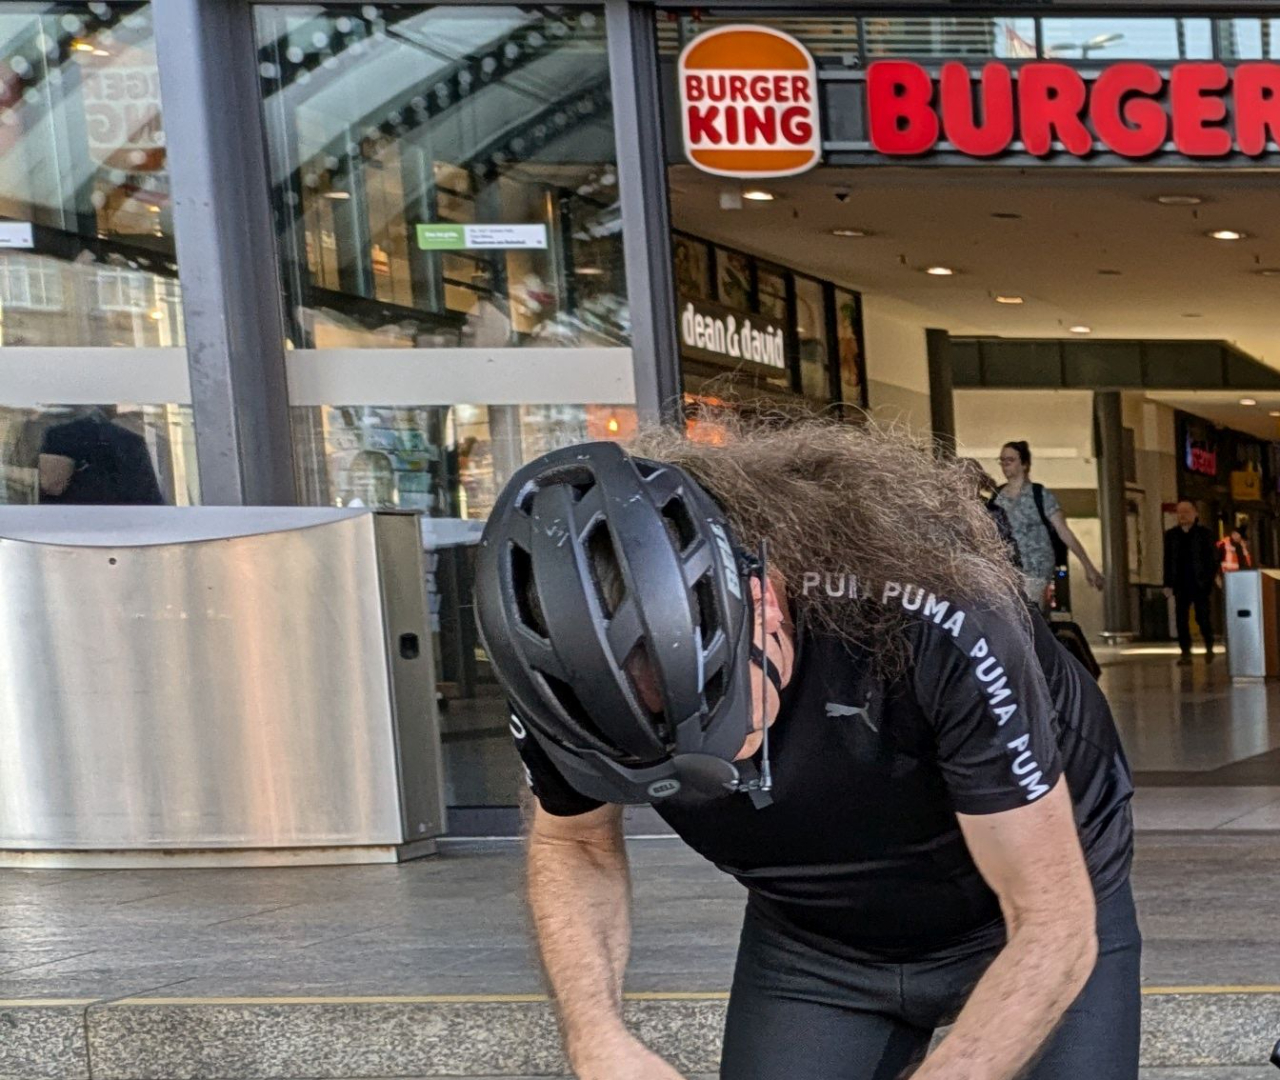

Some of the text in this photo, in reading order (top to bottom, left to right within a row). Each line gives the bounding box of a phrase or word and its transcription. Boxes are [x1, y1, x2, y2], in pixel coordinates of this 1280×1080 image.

[685, 75, 811, 102] BURGER
[688, 105, 813, 145] KING
[882, 581, 966, 637] PUMA
[970, 638, 1017, 726] PUMA
